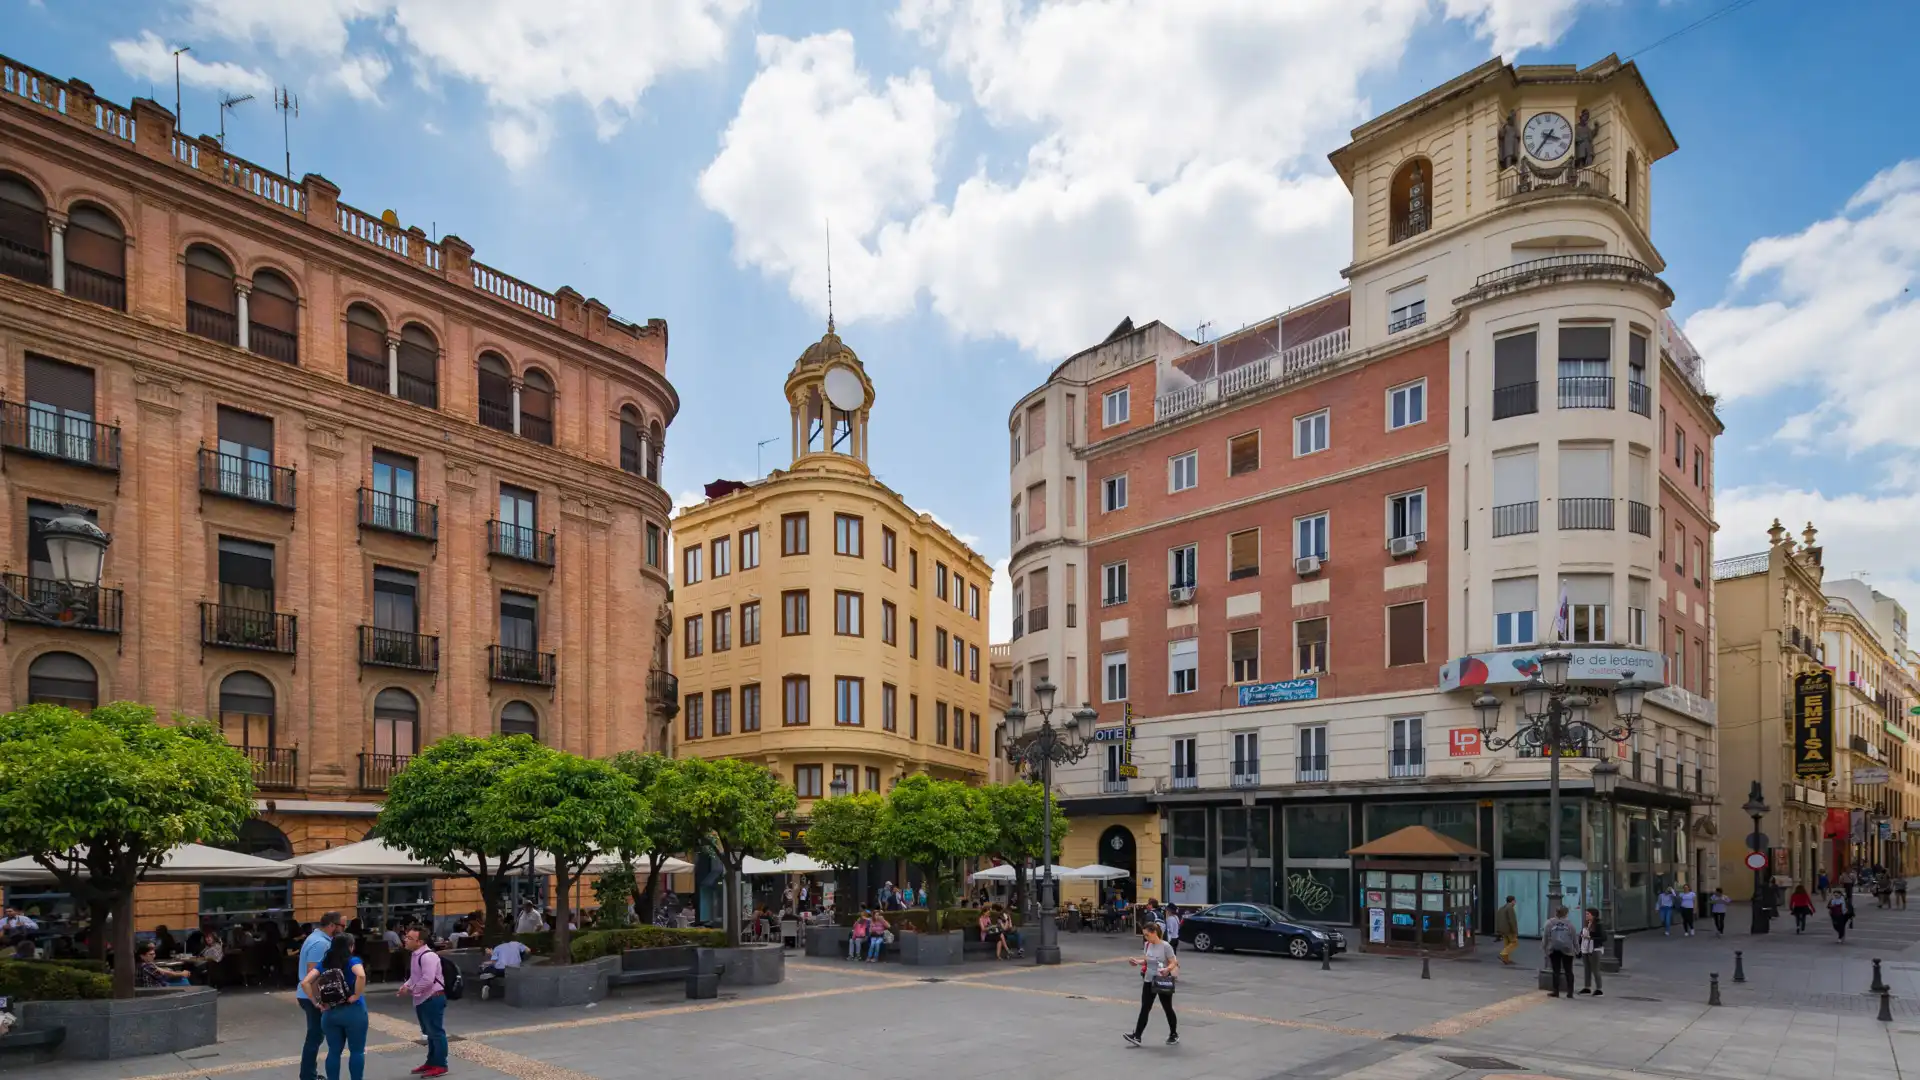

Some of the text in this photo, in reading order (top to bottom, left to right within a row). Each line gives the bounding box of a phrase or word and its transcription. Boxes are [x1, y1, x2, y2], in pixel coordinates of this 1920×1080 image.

[1589, 653, 1607, 666] de
[1610, 653, 1654, 668] ledesma
[1249, 679, 1315, 693] DANNA
[1803, 694, 1824, 760] EMFISA
[1096, 728, 1123, 741] OTE
